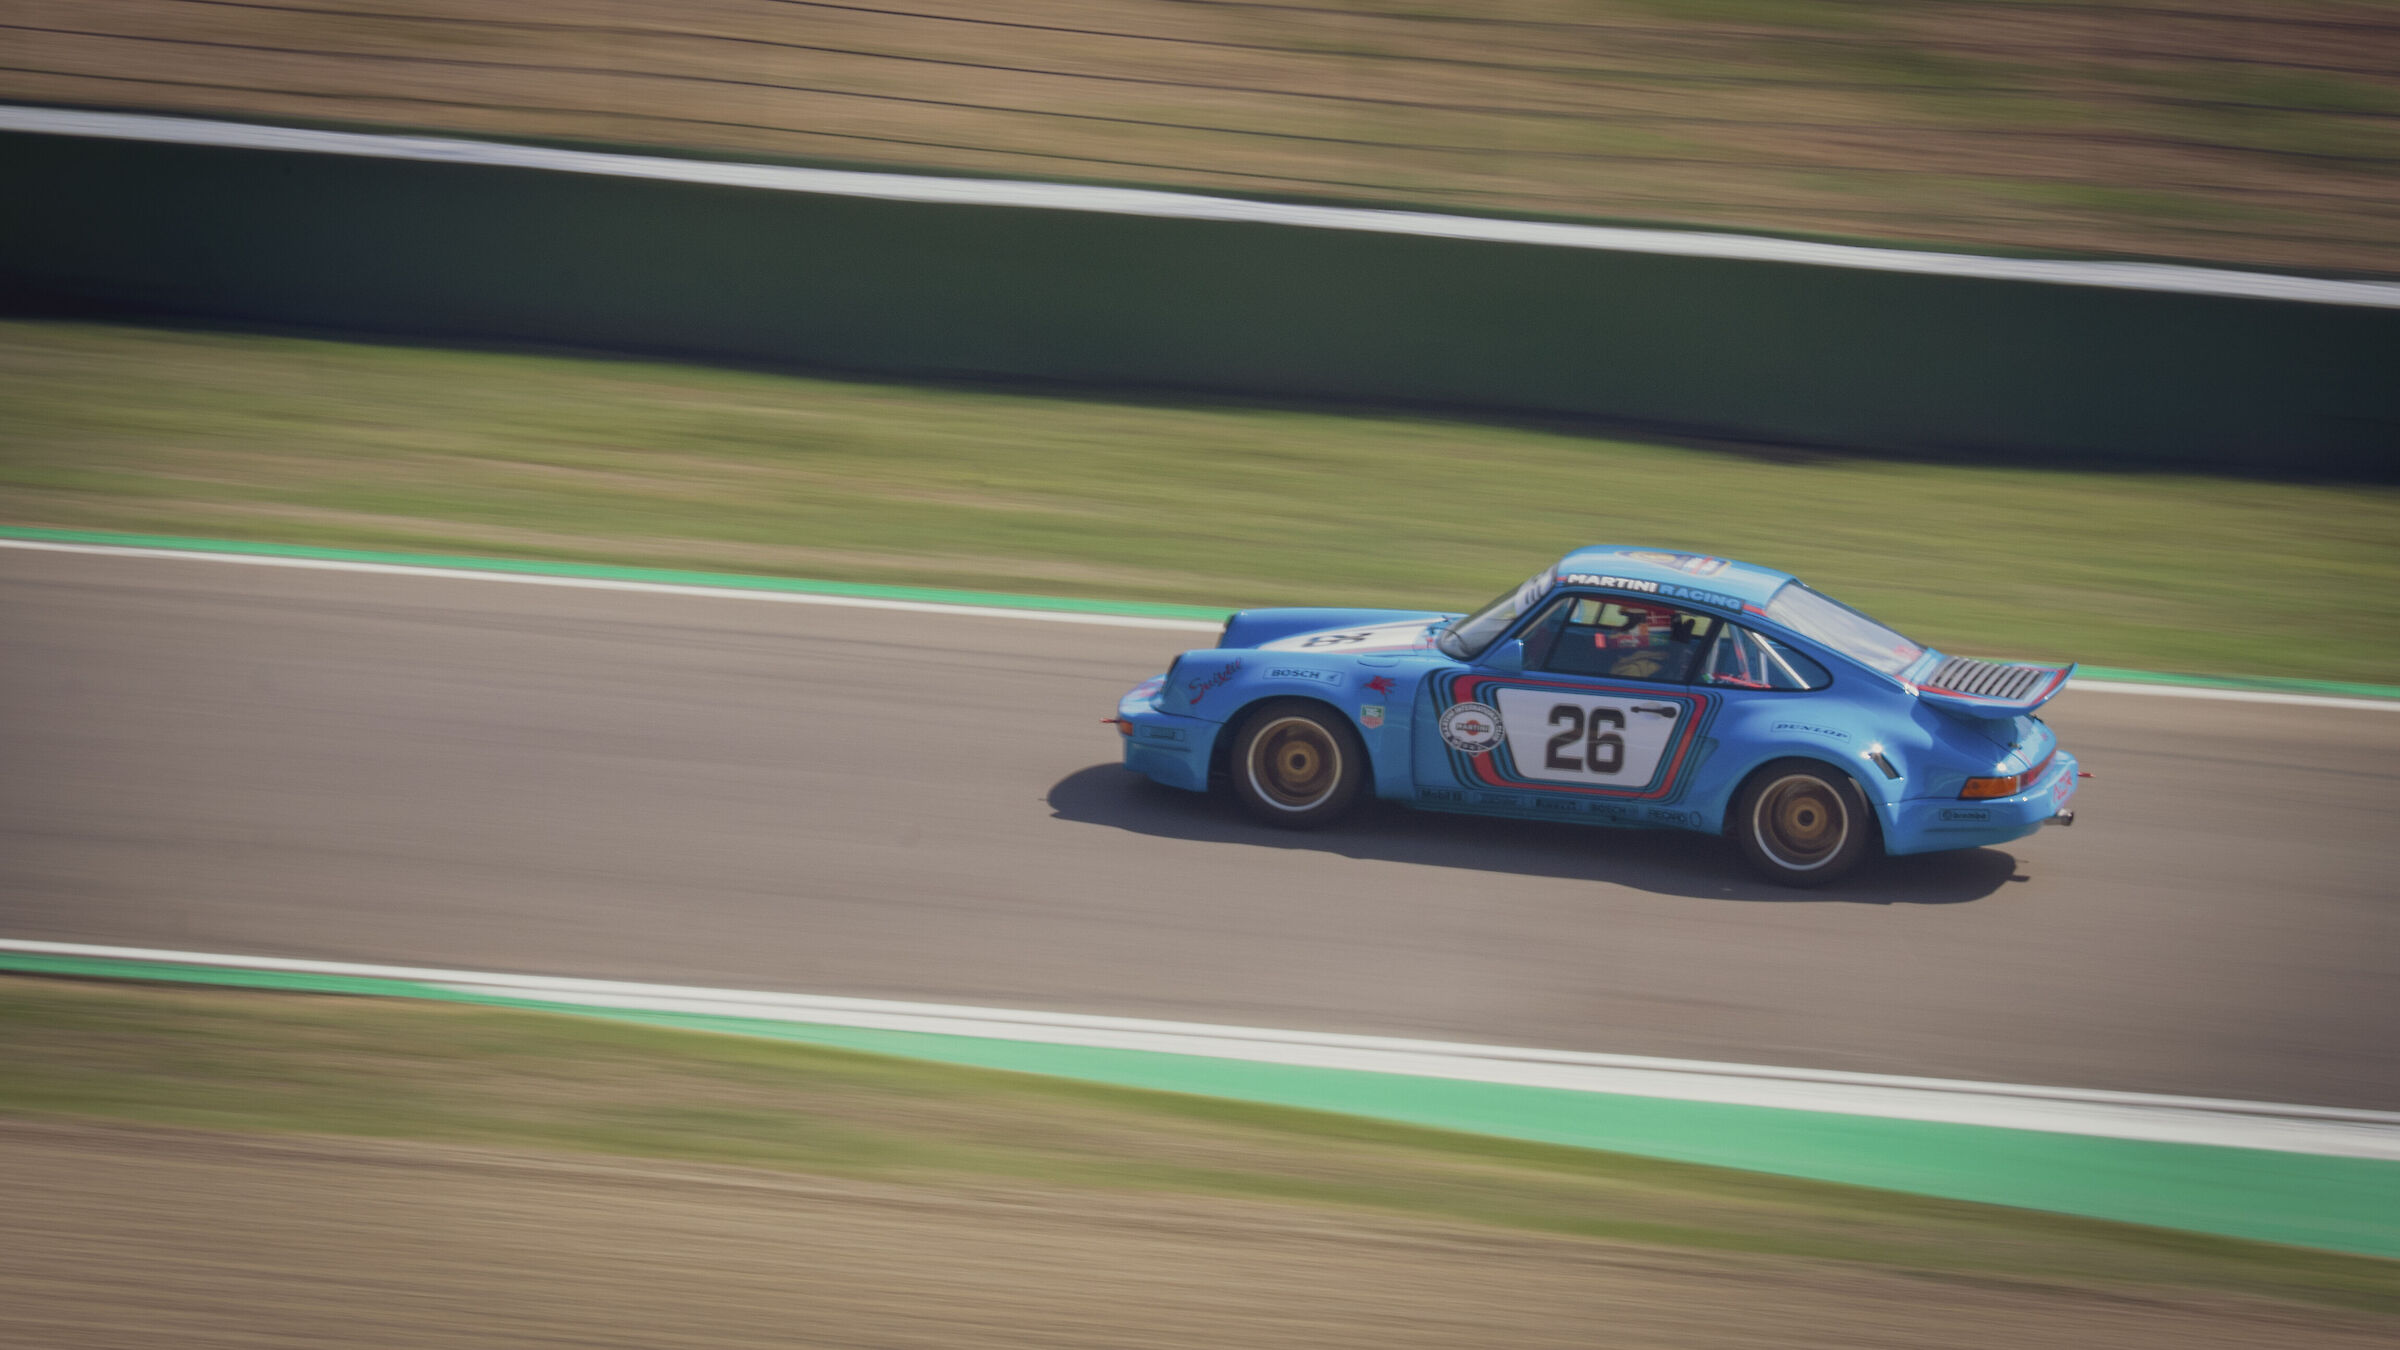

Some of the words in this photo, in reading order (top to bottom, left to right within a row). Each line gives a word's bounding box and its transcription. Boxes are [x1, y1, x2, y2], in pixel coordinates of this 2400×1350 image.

[1567, 573, 1658, 594] MARTINI
[1658, 583, 1742, 611] RACING
[1271, 669, 1321, 680] BOSCH
[1456, 722, 1490, 733] MARTINI
[1775, 723, 1849, 739] DUNLOP
[1544, 703, 1626, 776] 26
